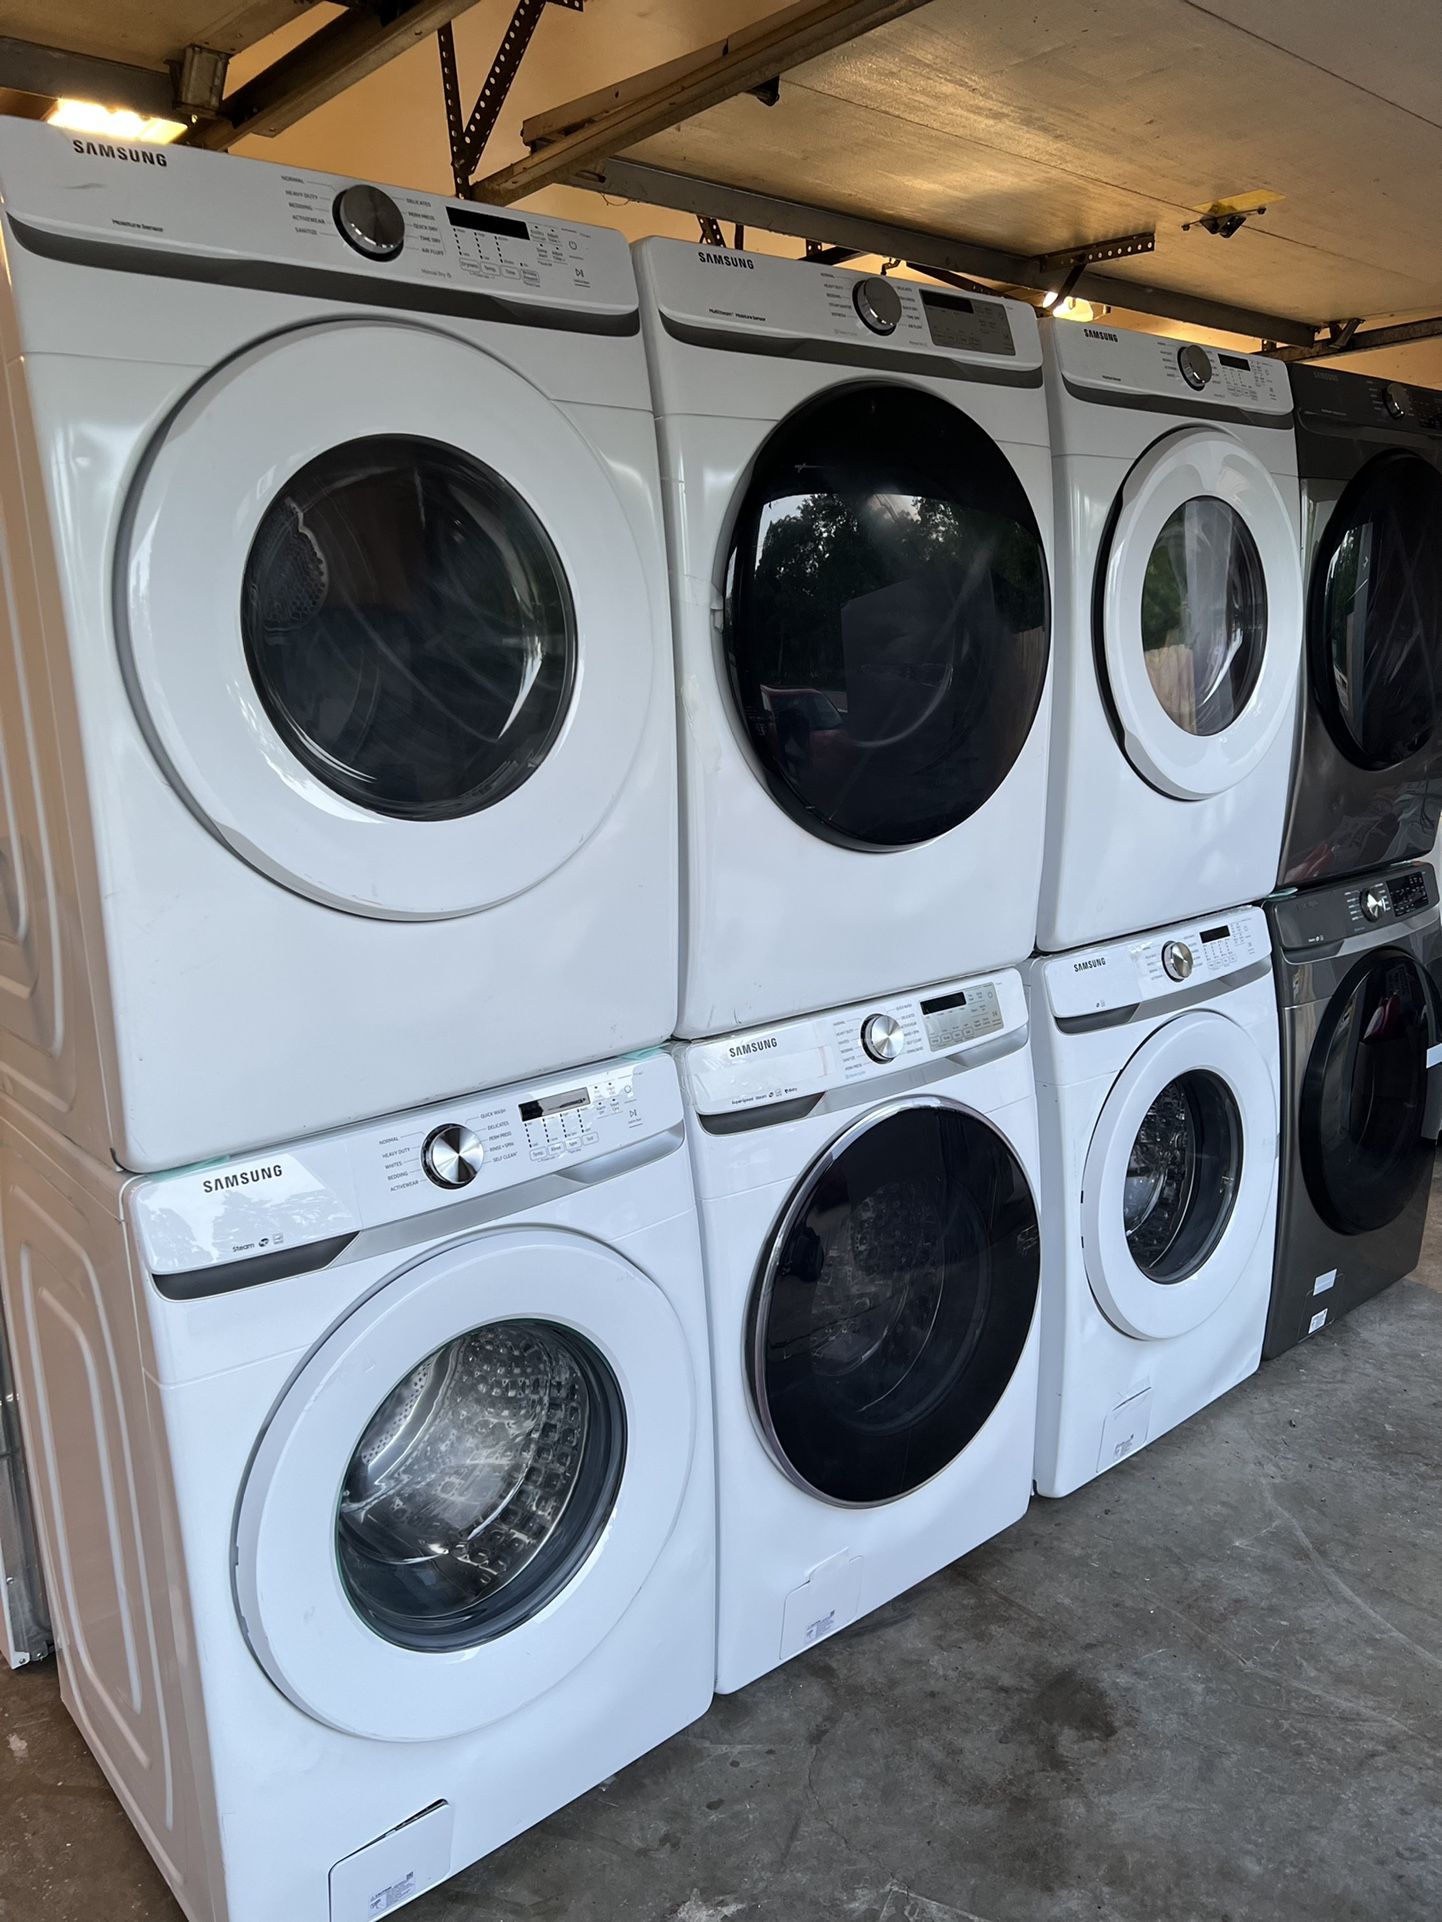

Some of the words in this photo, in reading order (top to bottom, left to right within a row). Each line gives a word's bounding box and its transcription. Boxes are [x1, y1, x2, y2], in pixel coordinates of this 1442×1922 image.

[72, 139, 168, 167] SAMSUNG
[698, 251, 754, 270] SAMSUNG
[1083, 328, 1119, 343] SAMSUNG
[1073, 957, 1106, 973] SAMSUNG
[729, 1037, 778, 1058] SAMSUNG
[202, 1164, 283, 1193] SAMSUNG
